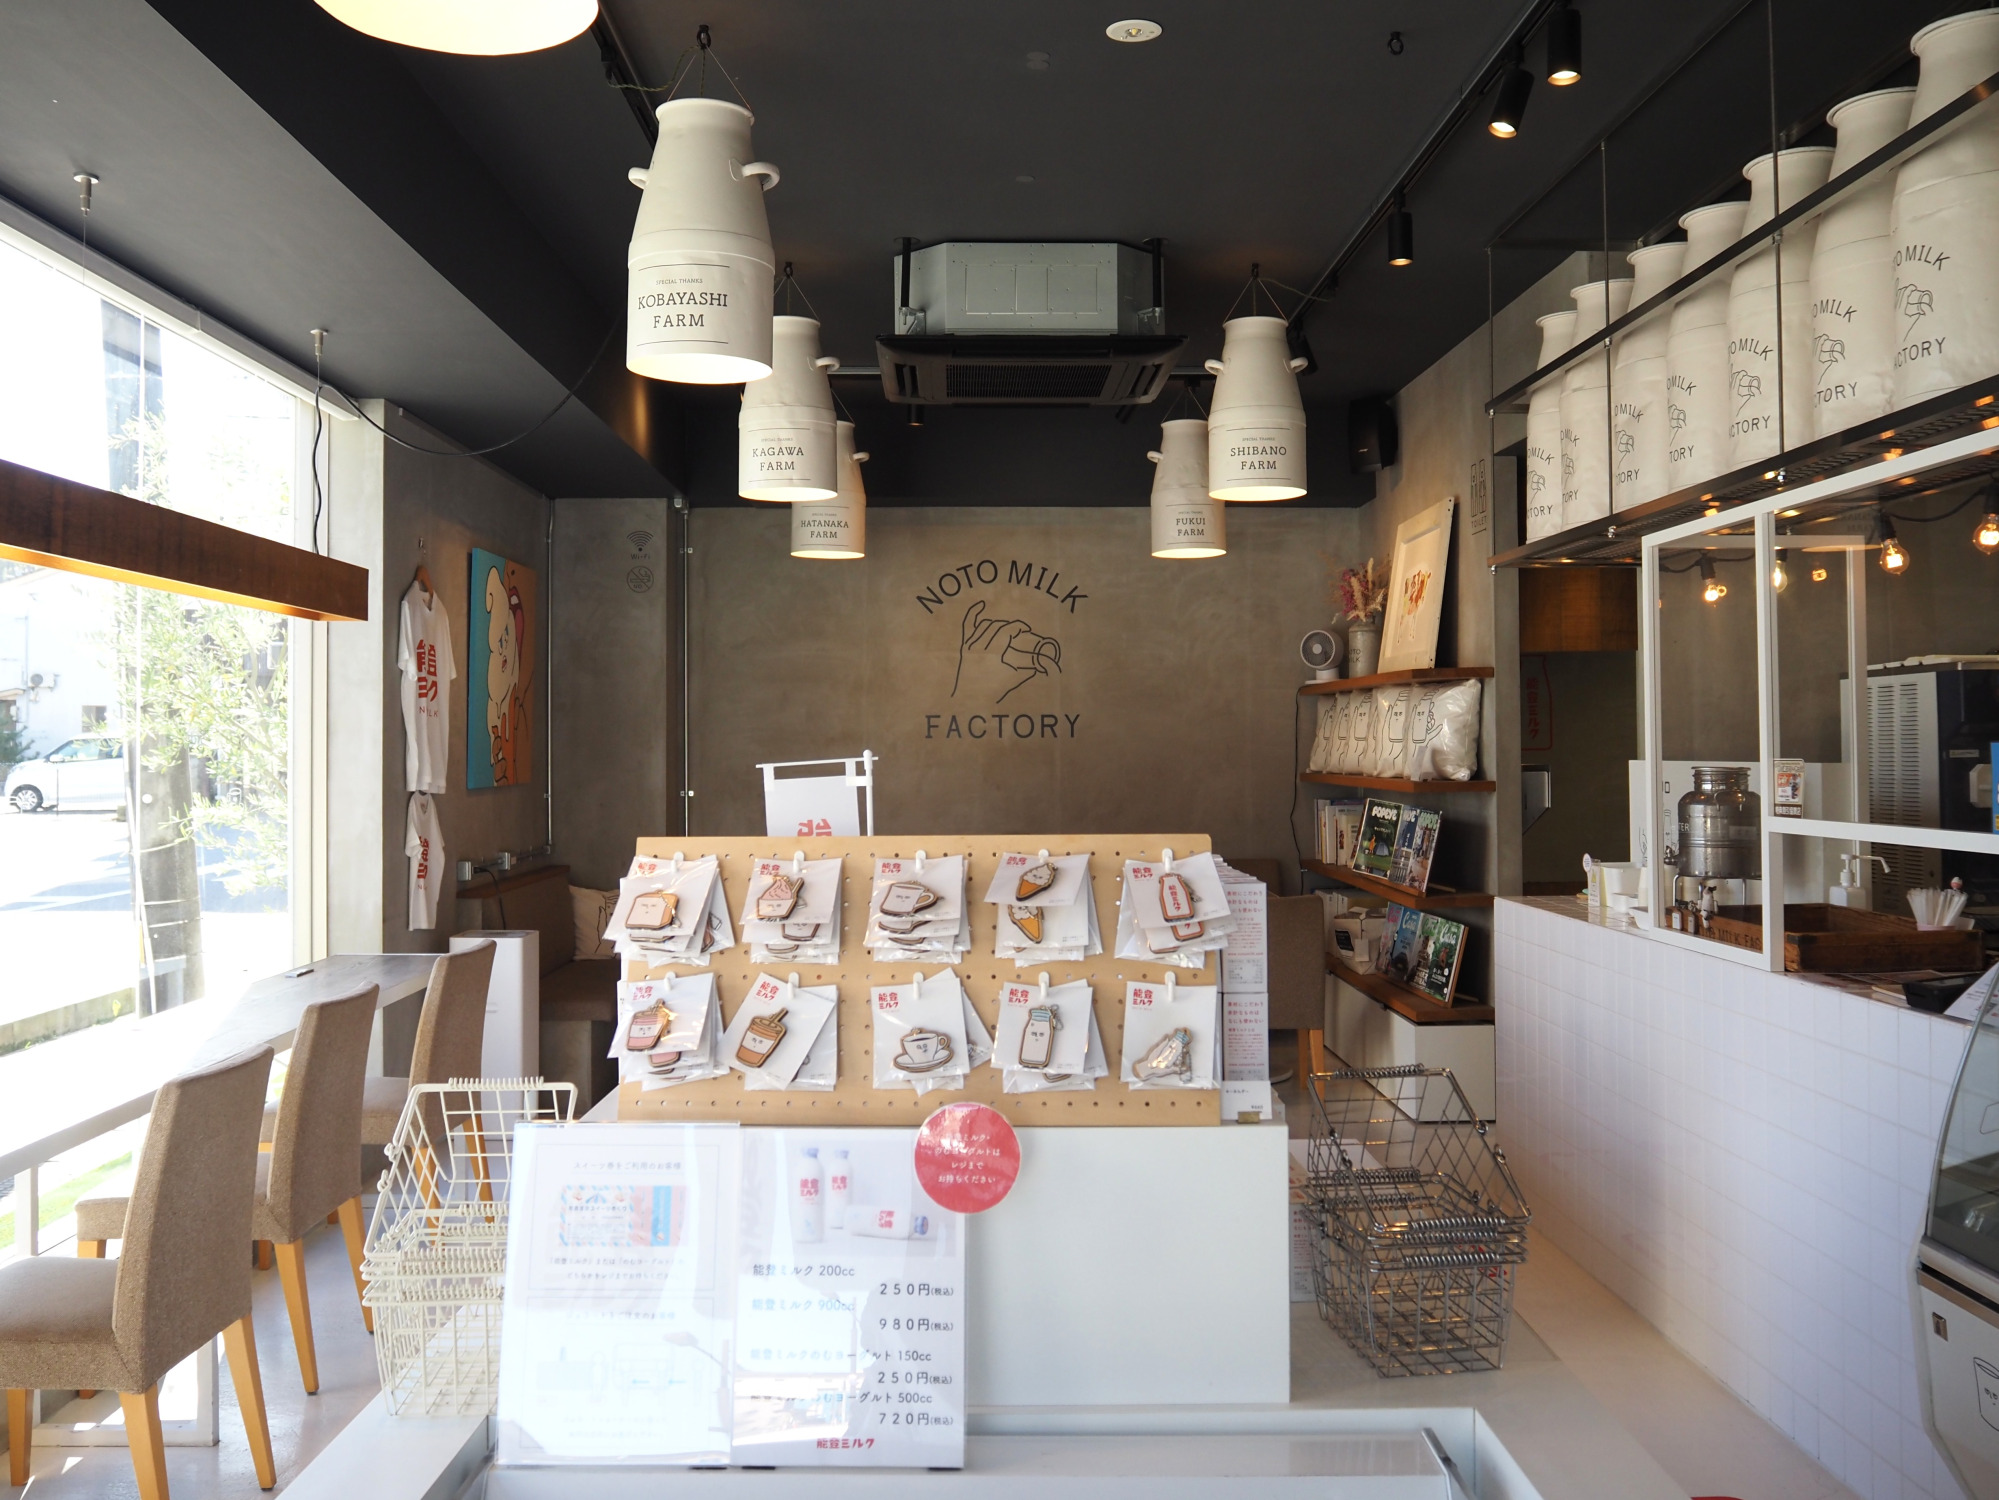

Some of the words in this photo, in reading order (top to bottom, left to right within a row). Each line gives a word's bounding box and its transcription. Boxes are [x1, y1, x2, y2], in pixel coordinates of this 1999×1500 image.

[1906, 244, 1951, 272] MILK
[638, 291, 728, 310] KOBAYASHI
[1820, 299, 1858, 324] MILK
[653, 313, 705, 329] FARM
[1738, 338, 1774, 361] MILK
[1672, 374, 1697, 396] MILK
[1619, 403, 1644, 424] MILK
[1564, 428, 1580, 447] MILK
[752, 446, 805, 458] KAGAWA
[1230, 445, 1287, 457] SHIBANO
[760, 461, 796, 471] FARM
[1240, 460, 1278, 470] FARM
[800, 520, 849, 529] HATANAKA
[1176, 517, 1206, 526] FUKUI
[810, 530, 838, 539] FARM
[1177, 528, 1205, 537] FARM
[916, 559, 998, 615] NOTO
[1008, 560, 1089, 614] MILK
[925, 713, 1081, 740] FACTORY
[1371, 805, 1398, 821] POPEYE
[1168, 885, 1181, 912] 能登ミルク
[760, 980, 780, 996] 能登
[1009, 987, 1030, 998] 能登
[1133, 988, 1154, 999] 能登
[878, 992, 899, 1003] 能登
[1007, 996, 1029, 1004] ミルク
[1132, 998, 1153, 1006] ミルク
[878, 1001, 899, 1010] ミルク
[951, 1160, 985, 1170] レジまで
[937, 1174, 996, 1184] お持ちください
[752, 1263, 814, 1277] 能登ミルク
[818, 1264, 856, 1277] 200cc
[751, 1298, 814, 1312] 能登ミルク
[818, 1299, 856, 1312] 900cc
[750, 1349, 892, 1362] 能登ミルクのむヨーグルト
[898, 1350, 933, 1362] 150cc
[897, 1392, 934, 1405] 500cc
[816, 1438, 876, 1450] 能登ミルク
